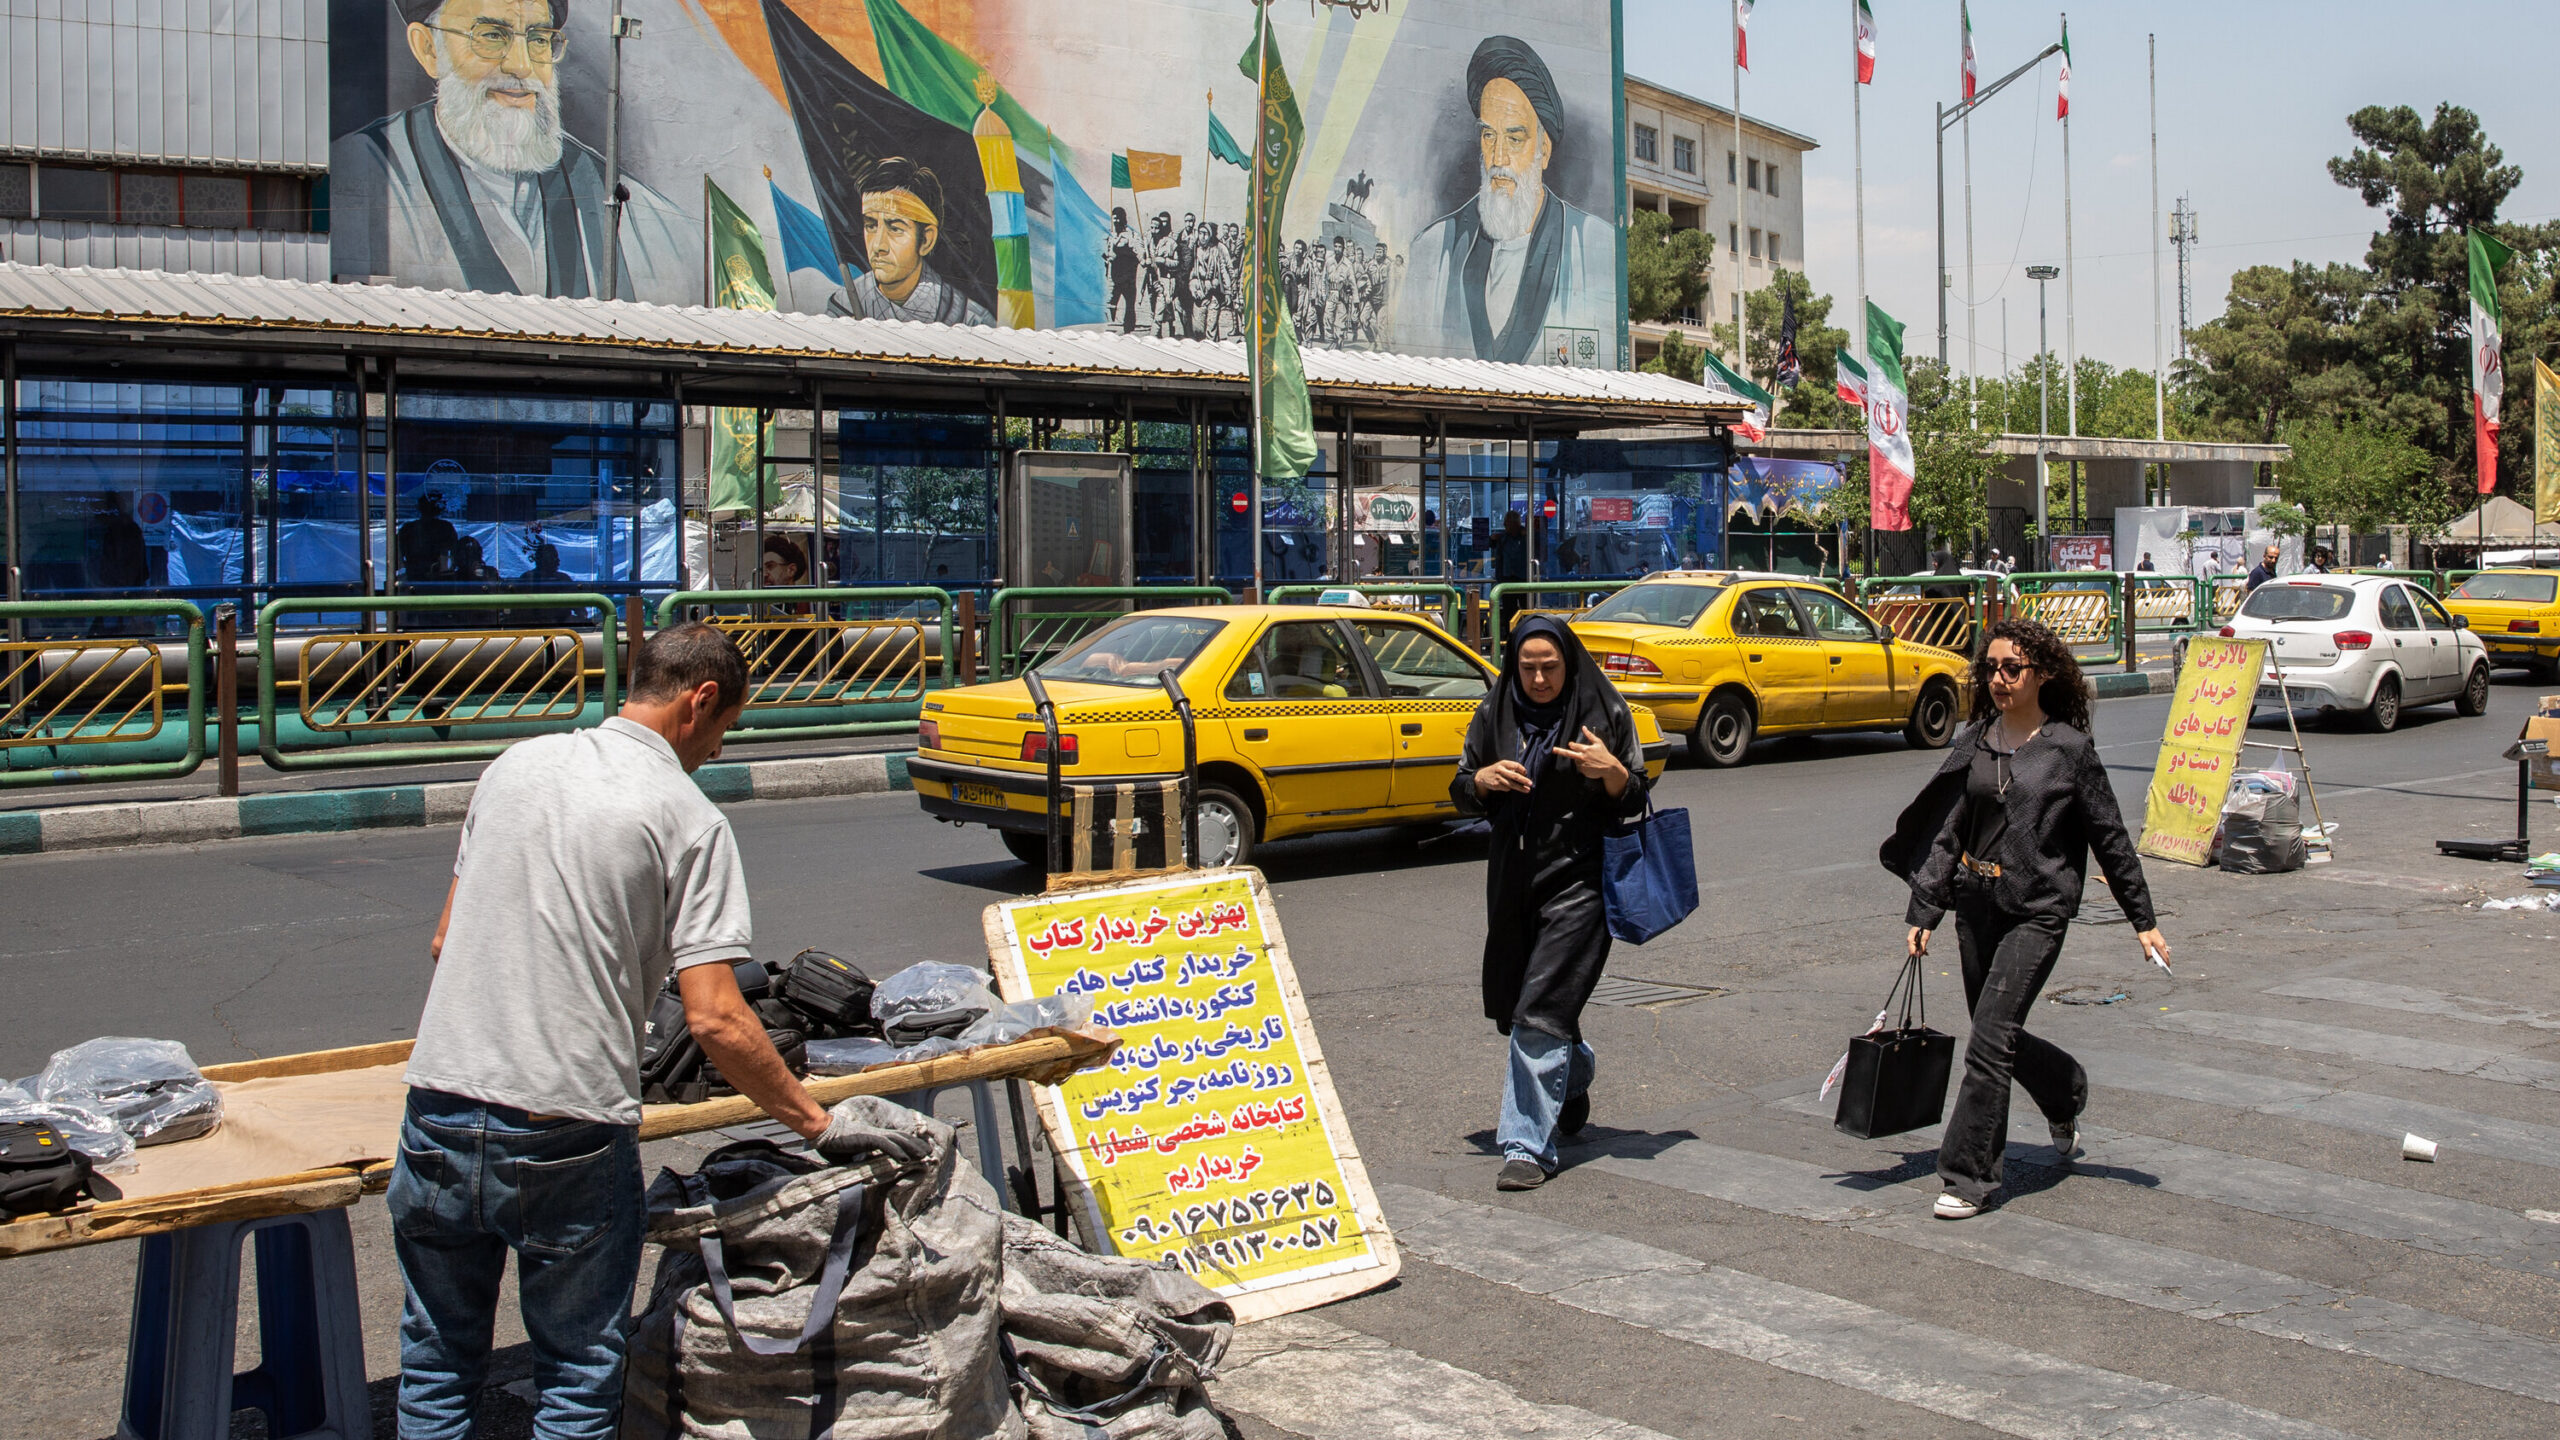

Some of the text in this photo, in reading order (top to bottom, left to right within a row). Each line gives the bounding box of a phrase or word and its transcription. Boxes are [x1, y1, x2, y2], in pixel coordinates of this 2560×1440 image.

[2198, 643, 2247, 670] بالاترین
[2188, 678, 2237, 706] خریدار
[2173, 711, 2238, 740] کتاب های
[2167, 751, 2220, 773] دست دو
[1029, 903, 1248, 957] بهترین خریدار کتاب
[1111, 957, 1165, 991] کتاب
[1177, 946, 1254, 985] خریدار
[1231, 1096, 1305, 1131] کتابخانه
[1155, 1112, 1226, 1153] شخصی
[1168, 1147, 1261, 1192] خریداریم
[1123, 1181, 1334, 1242] ۰۹۰۱۶۷۵۴۶۳۵
[1163, 1217, 1338, 1273] ۹۱۹۹۱۳۰۰۵۷
